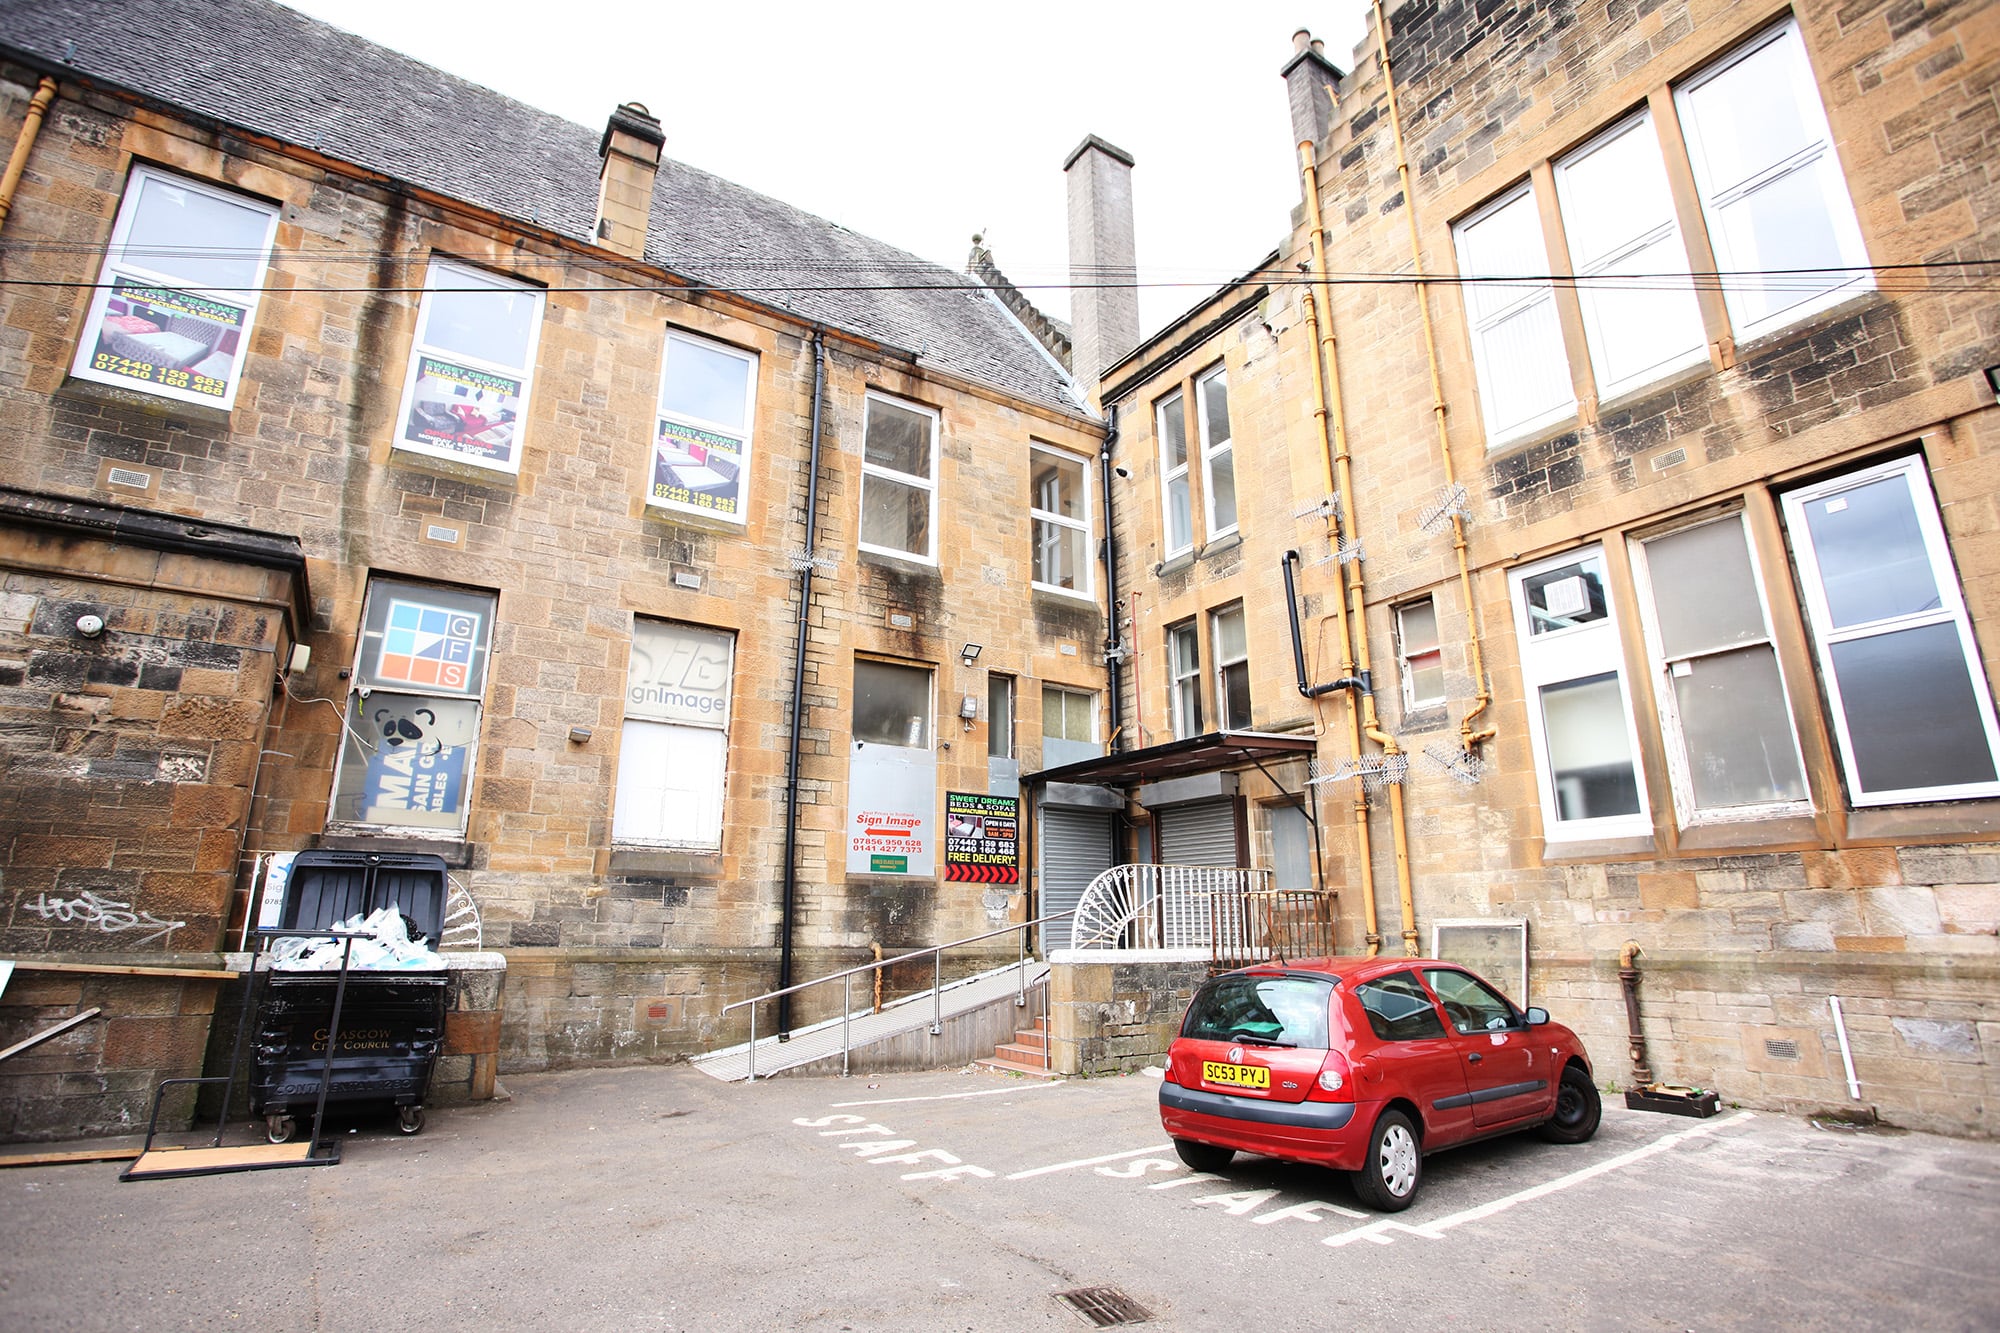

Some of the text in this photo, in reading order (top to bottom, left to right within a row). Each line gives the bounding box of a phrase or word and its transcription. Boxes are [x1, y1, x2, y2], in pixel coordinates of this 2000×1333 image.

[124, 280, 239, 314] SEET DREAMZ
[121, 291, 189, 313] MANUFACTURER
[198, 311, 237, 325] RETAILER
[186, 303, 238, 320] SOFAS
[95, 361, 223, 396] 07440 160 468
[97, 353, 225, 388] 07440 159 683
[425, 365, 459, 378] BEDS
[473, 377, 514, 392] SOFAS
[426, 360, 515, 388] SWEET DREAMZ
[424, 428, 455, 440] OPEN
[465, 438, 493, 449] DAYS
[664, 428, 692, 439] BEDS
[705, 438, 738, 450] SOFAS
[665, 423, 738, 445] SWEET DREAMZ
[655, 483, 735, 507] 07440 159 683
[655, 489, 735, 513] 07440 160 468
[949, 794, 1016, 807] SWEET DREAMZ
[949, 801, 975, 809] BEDS
[986, 804, 1016, 812] SOFAS
[856, 814, 883, 826] Sign
[886, 815, 922, 828] Image
[949, 807, 988, 816] MANUFACTURER
[994, 810, 1016, 818] RETAILER
[853, 837, 922, 847] 07856 950 628
[880, 845, 897, 853] 427
[900, 846, 922, 854] 7373
[948, 838, 1015, 849] 07440 159 683
[948, 844, 1015, 856] 07440 160 468
[948, 852, 971, 862] FREE
[314, 1028, 392, 1041] GASGOW
[343, 1040, 390, 1050] COUNCIL
[1207, 1064, 1236, 1081] SC53
[1240, 1067, 1265, 1084] PYJ
[276, 1081, 374, 1096] CONTIENTAL
[792, 1114, 997, 1182] STAFF
[1094, 1157, 1447, 1248] STAFF
